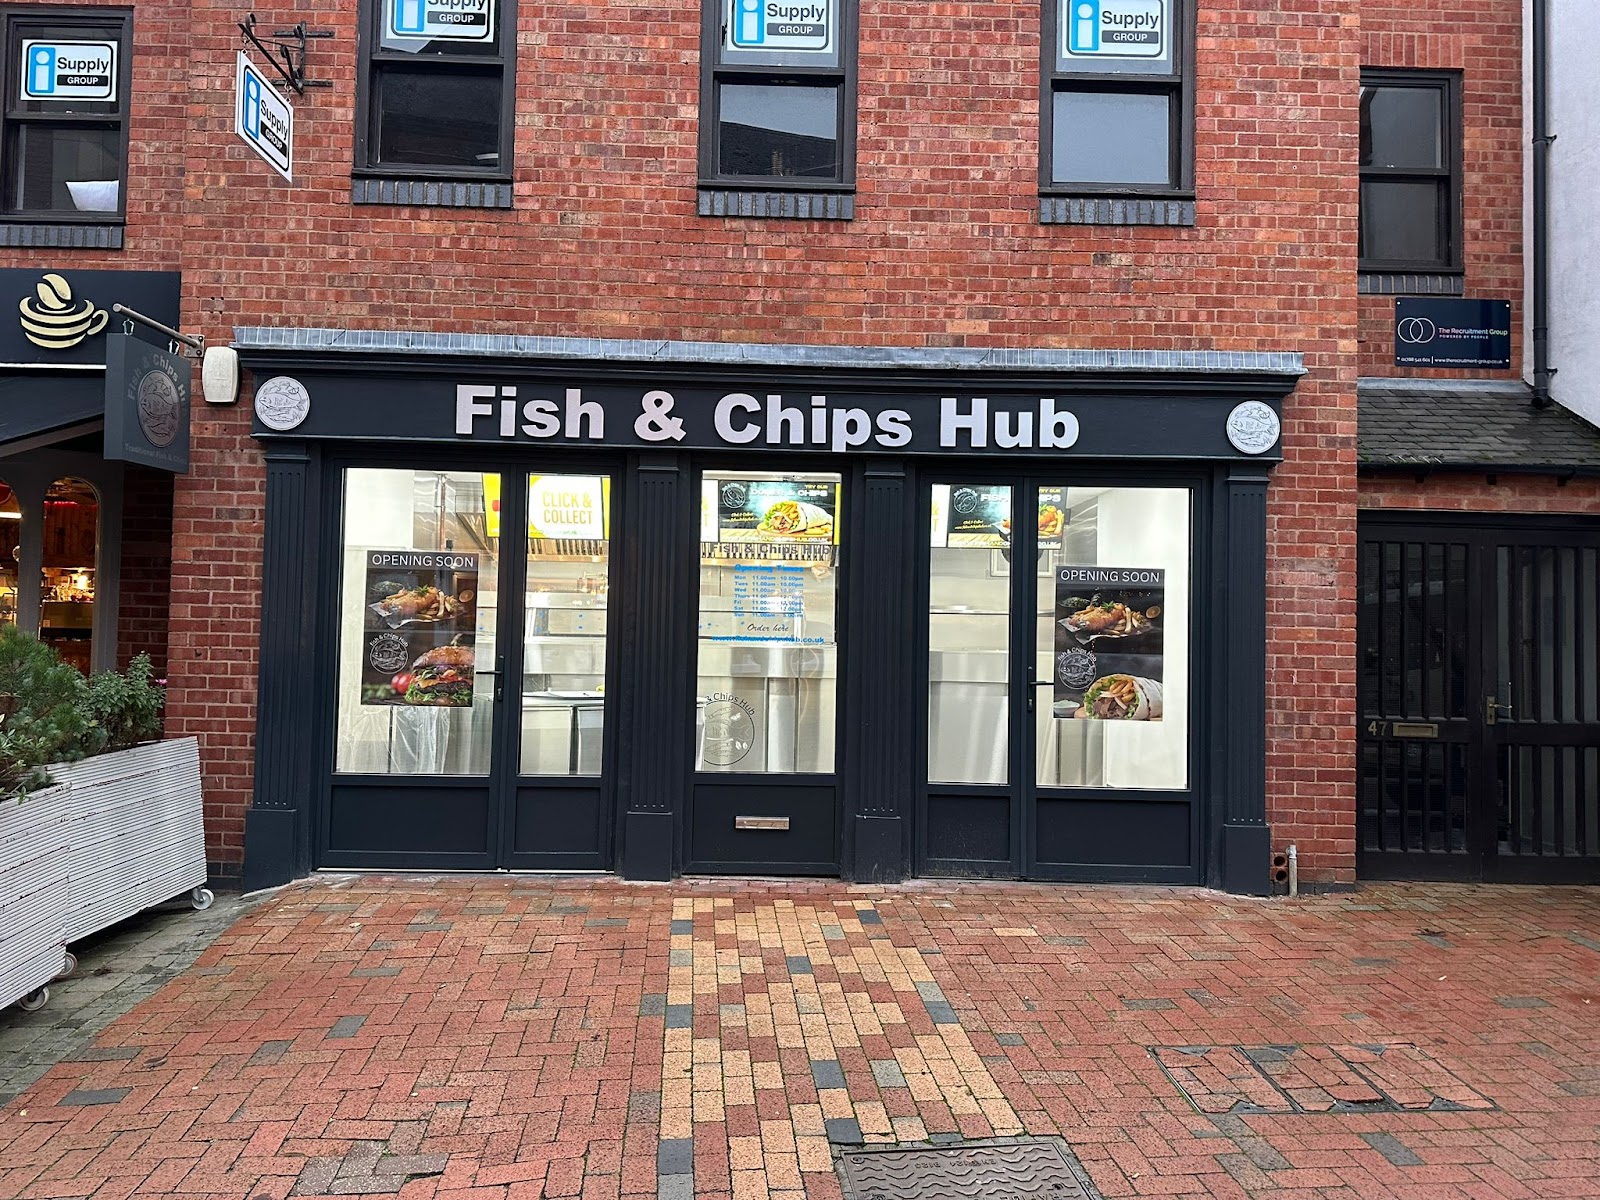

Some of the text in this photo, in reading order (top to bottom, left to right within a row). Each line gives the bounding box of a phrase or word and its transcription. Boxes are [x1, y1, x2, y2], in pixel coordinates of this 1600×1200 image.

[439, 14, 474, 23] GROUP
[767, 4, 824, 22] Supply
[1101, 10, 1159, 29] Supply
[778, 26, 813, 34] GROUP
[1113, 33, 1148, 41] GROUP
[57, 57, 109, 73] Supply
[67, 77, 99, 85] GROUP
[260, 99, 288, 140] Supply
[265, 128, 283, 149] GROUP
[1451, 327, 1489, 335] Recruitment
[1489, 328, 1508, 336] Group
[127, 368, 142, 400] Fish
[153, 353, 179, 383] Chips
[455, 384, 1080, 453] Fish & Chips Hub
[542, 490, 592, 508] CLICK &
[543, 509, 593, 525] COLLECT
[712, 543, 831, 555] Fish & Chips Hub
[372, 554, 474, 568] OPENING SOON
[734, 563, 804, 573] Opening Times
[1060, 569, 1160, 583] OPENING SOON
[746, 623, 789, 632] Order here
[713, 692, 739, 702] Chips
[739, 698, 755, 716] Hub
[1367, 720, 1388, 736] 47
